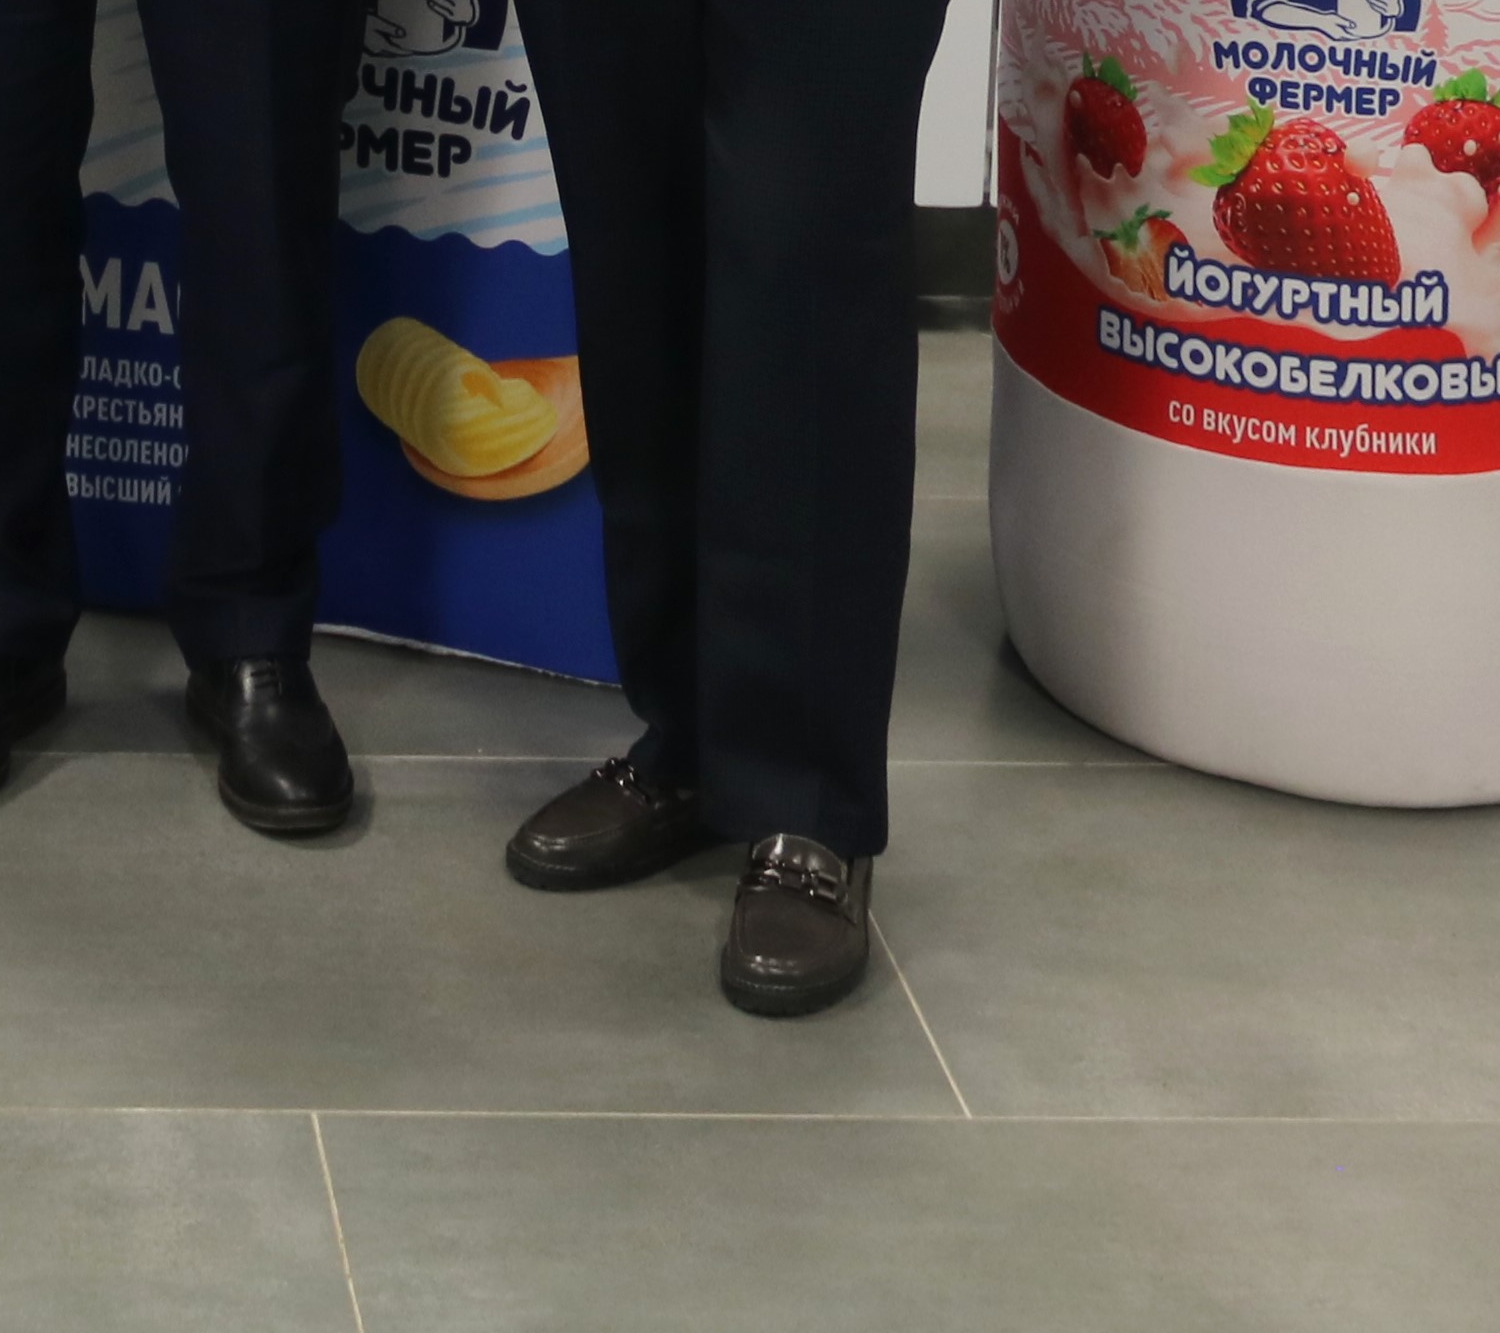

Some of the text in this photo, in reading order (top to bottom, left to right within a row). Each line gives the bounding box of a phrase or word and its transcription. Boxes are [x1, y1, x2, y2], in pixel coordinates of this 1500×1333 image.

[1212, 40, 1438, 88] МОЛОЧНЫЙ
[347, 63, 531, 141] ЧНЫЙ
[1247, 77, 1401, 117] ФЕРМЕР
[79, 254, 181, 335] МА
[1166, 245, 1446, 326] ЙОГУРТНЫЙ
[66, 433, 188, 468] НЕСОЛЕНО
[1168, 399, 1437, 457] со вкусом клубники
[65, 472, 172, 506] ВЫСШИЙ
